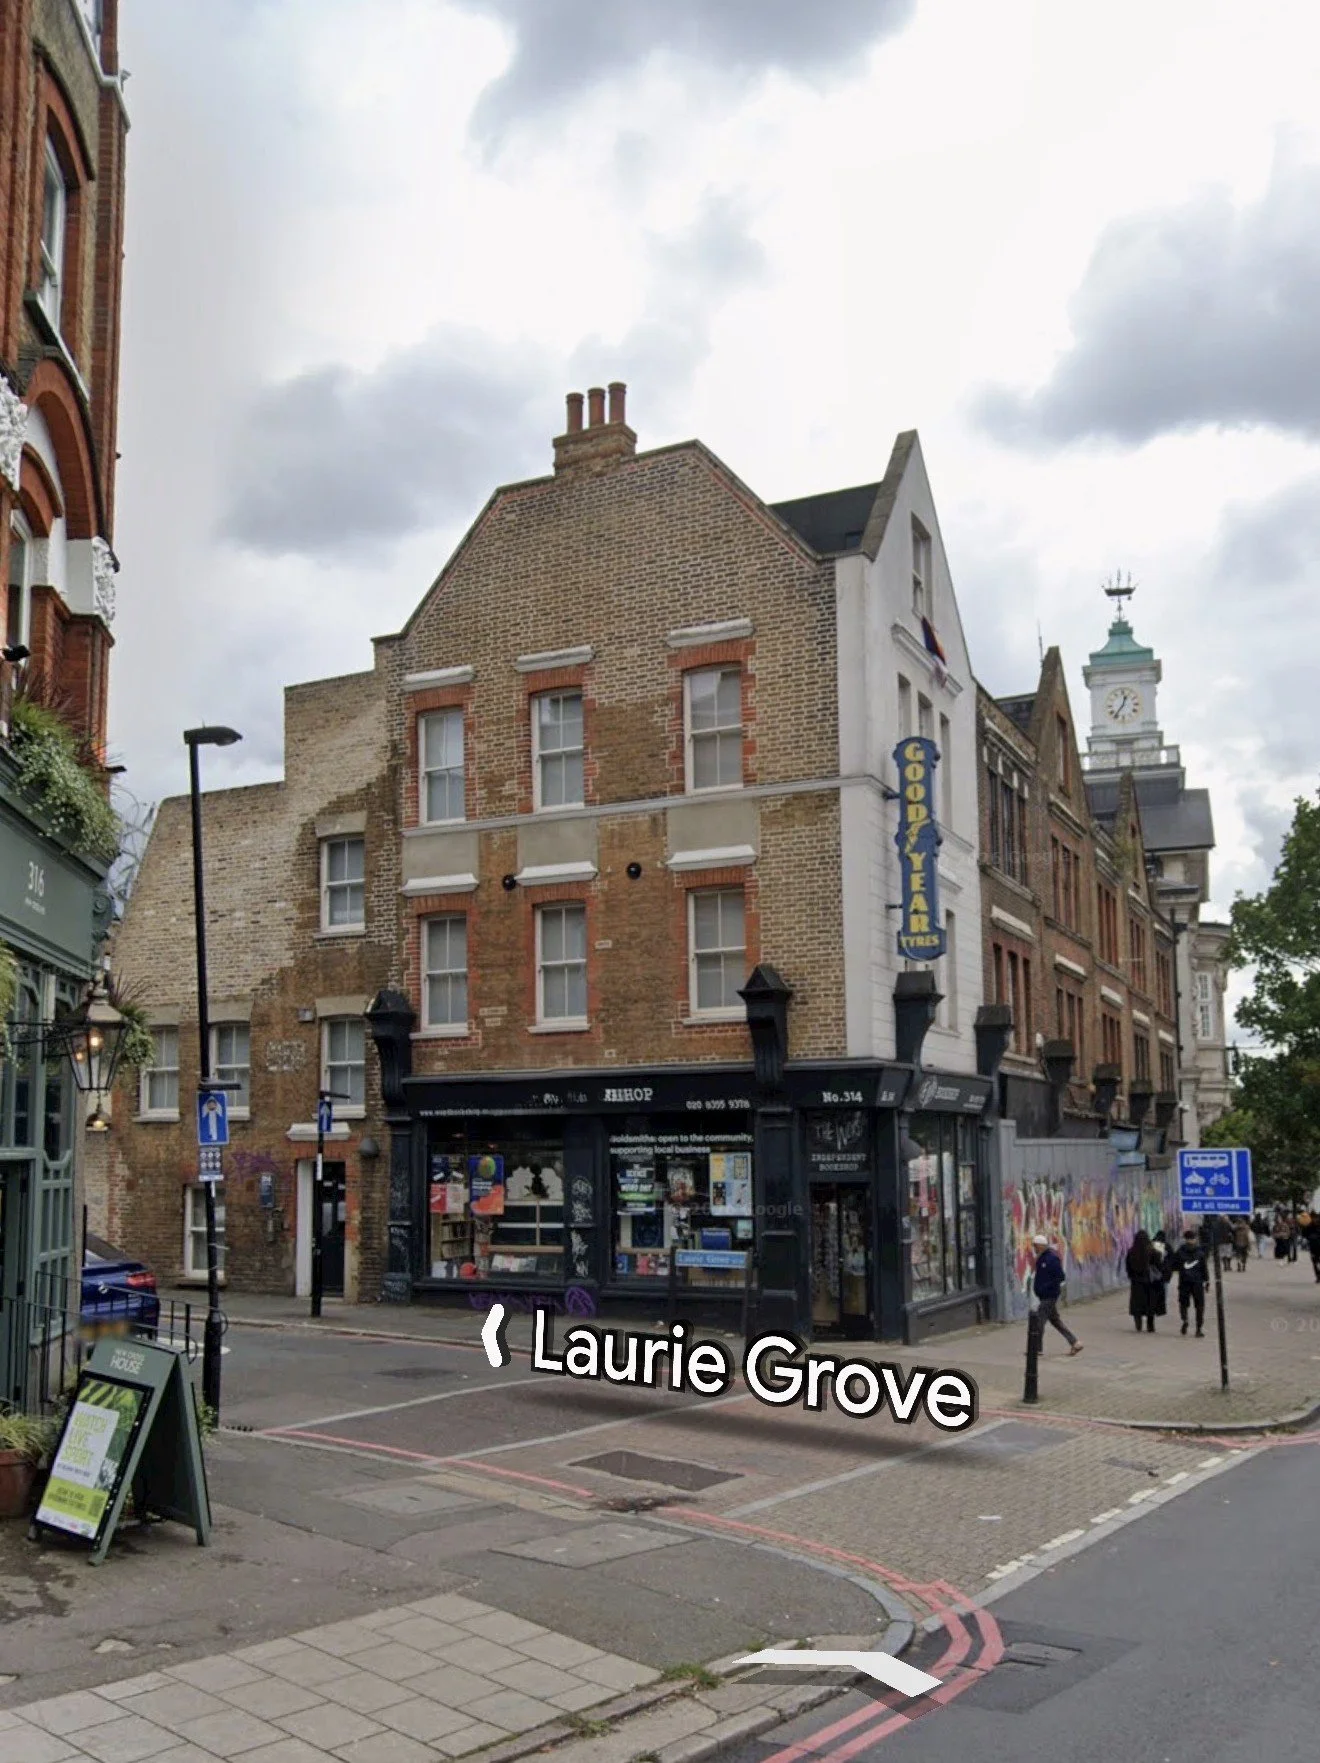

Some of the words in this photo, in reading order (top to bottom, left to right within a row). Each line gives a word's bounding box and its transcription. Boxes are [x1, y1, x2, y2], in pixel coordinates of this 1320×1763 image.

[904, 742, 930, 933] GOODYEAR
[28, 861, 45, 897] 316
[901, 934, 939, 948] TYRES
[1192, 1201, 1201, 1209] At
[1216, 1201, 1240, 1210] times
[110, 1355, 144, 1375] HOUSE
